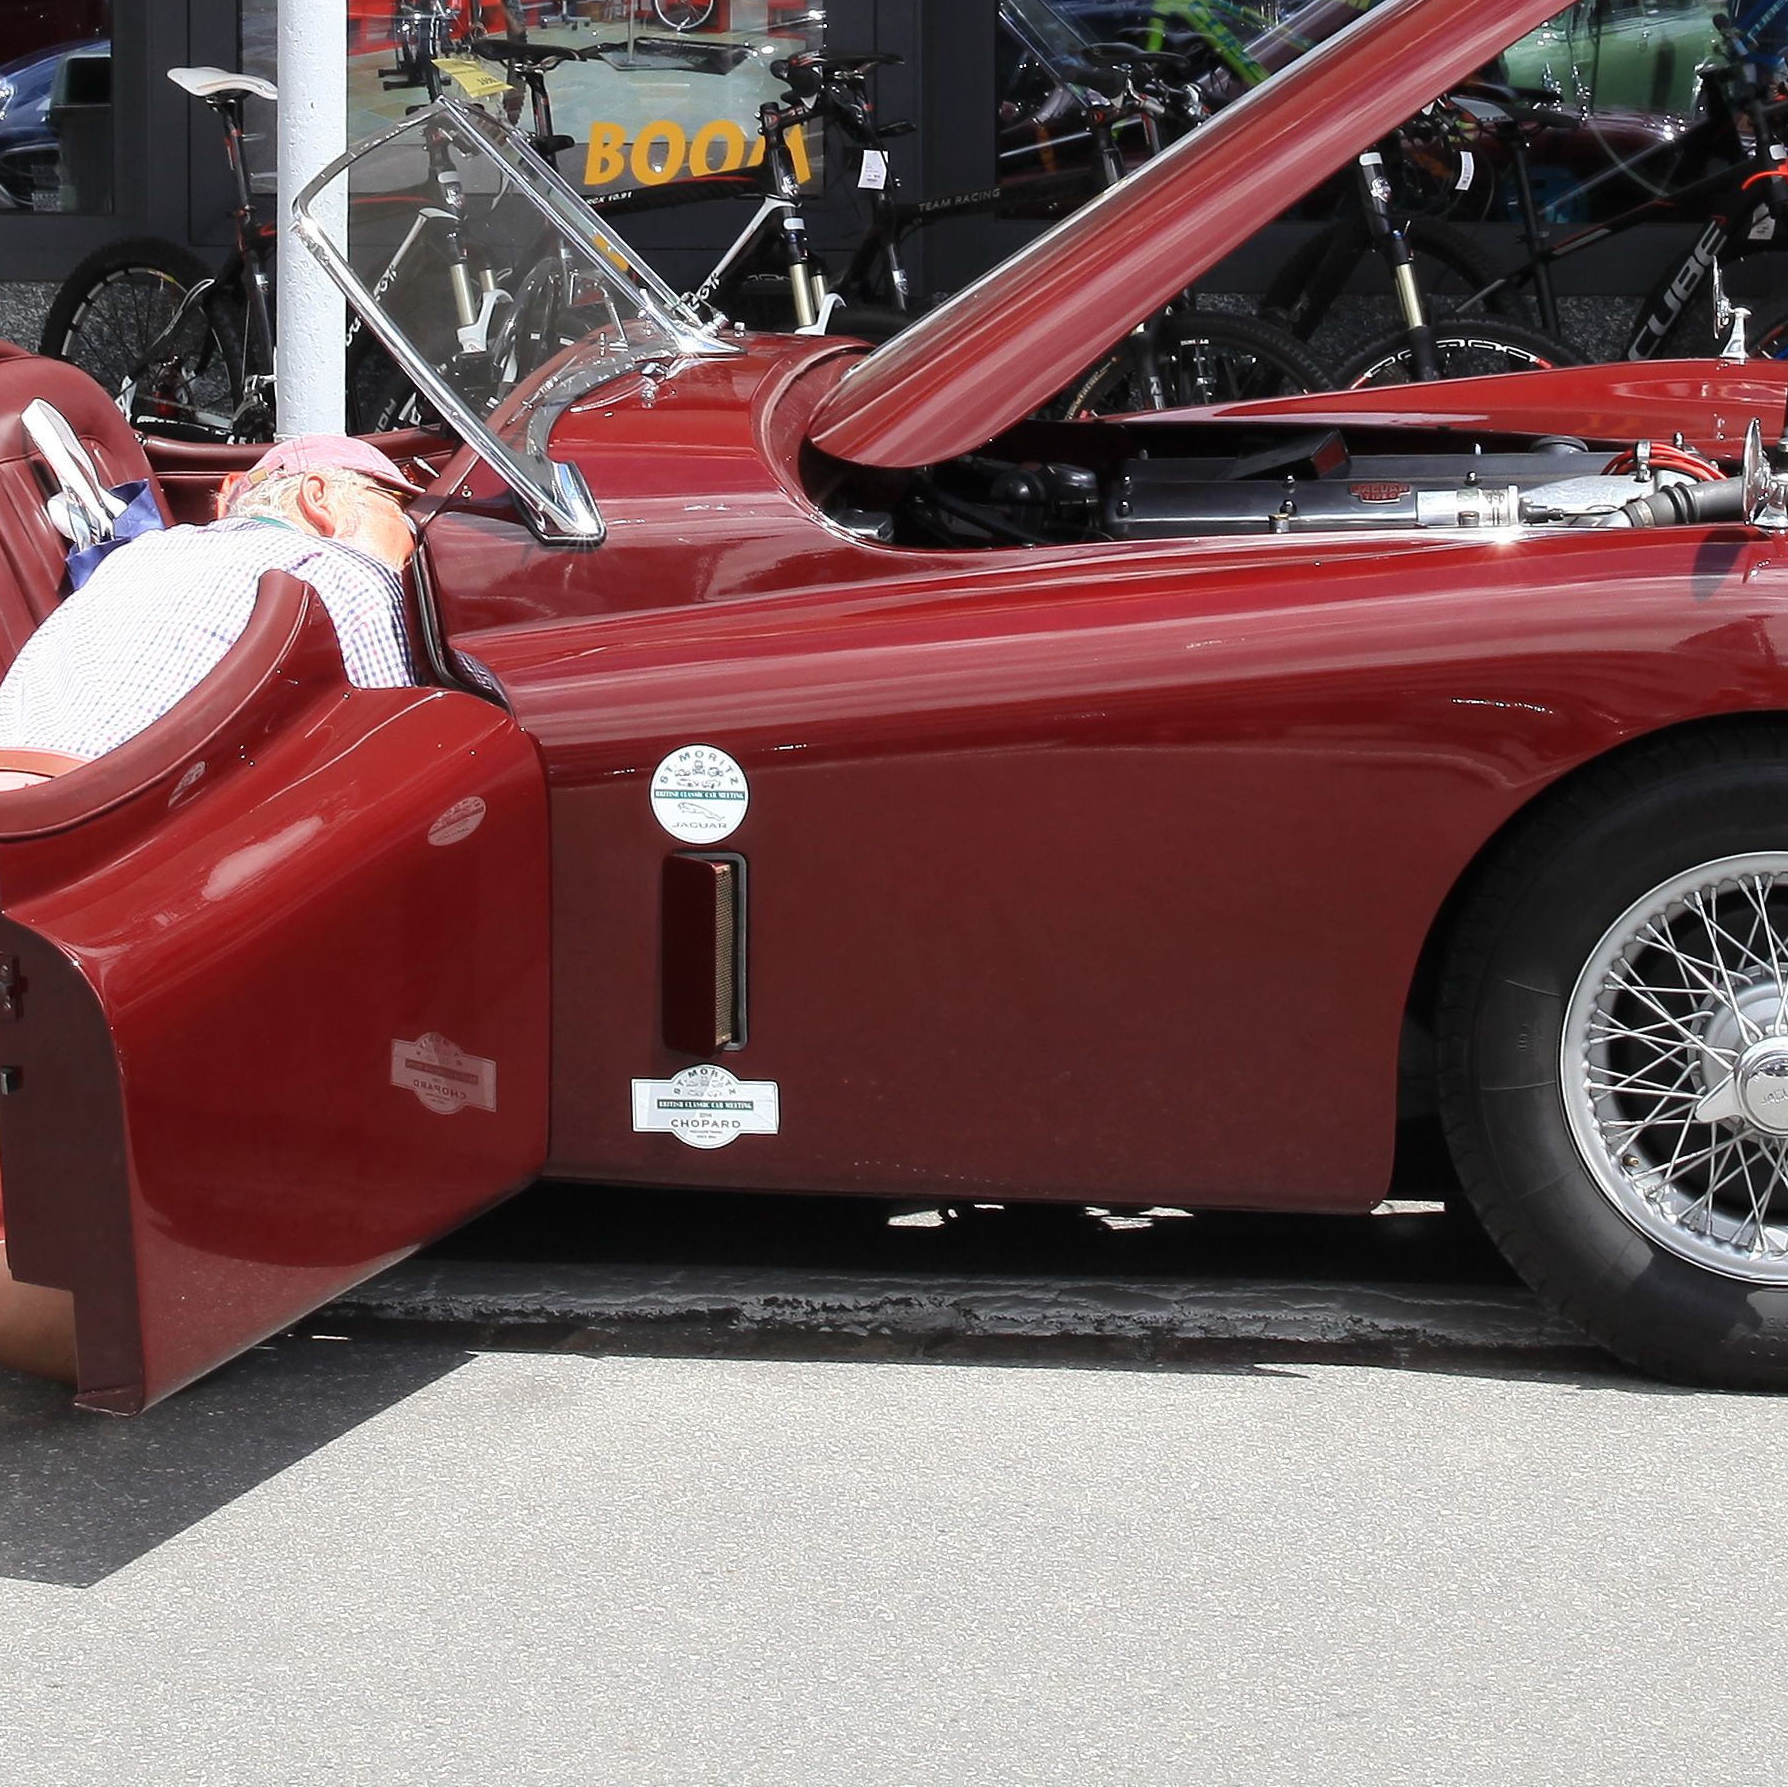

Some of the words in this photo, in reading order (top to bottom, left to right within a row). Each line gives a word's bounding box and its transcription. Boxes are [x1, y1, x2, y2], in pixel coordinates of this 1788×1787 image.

[917, 197, 952, 212] TEAM
[954, 187, 1001, 206] RACING
[1627, 220, 1728, 361] CUBE
[678, 749, 739, 786] MORITZ
[672, 820, 728, 829] JAGUAR
[687, 1068, 737, 1095] MORITZ
[670, 1118, 741, 1129] CHOPARD
